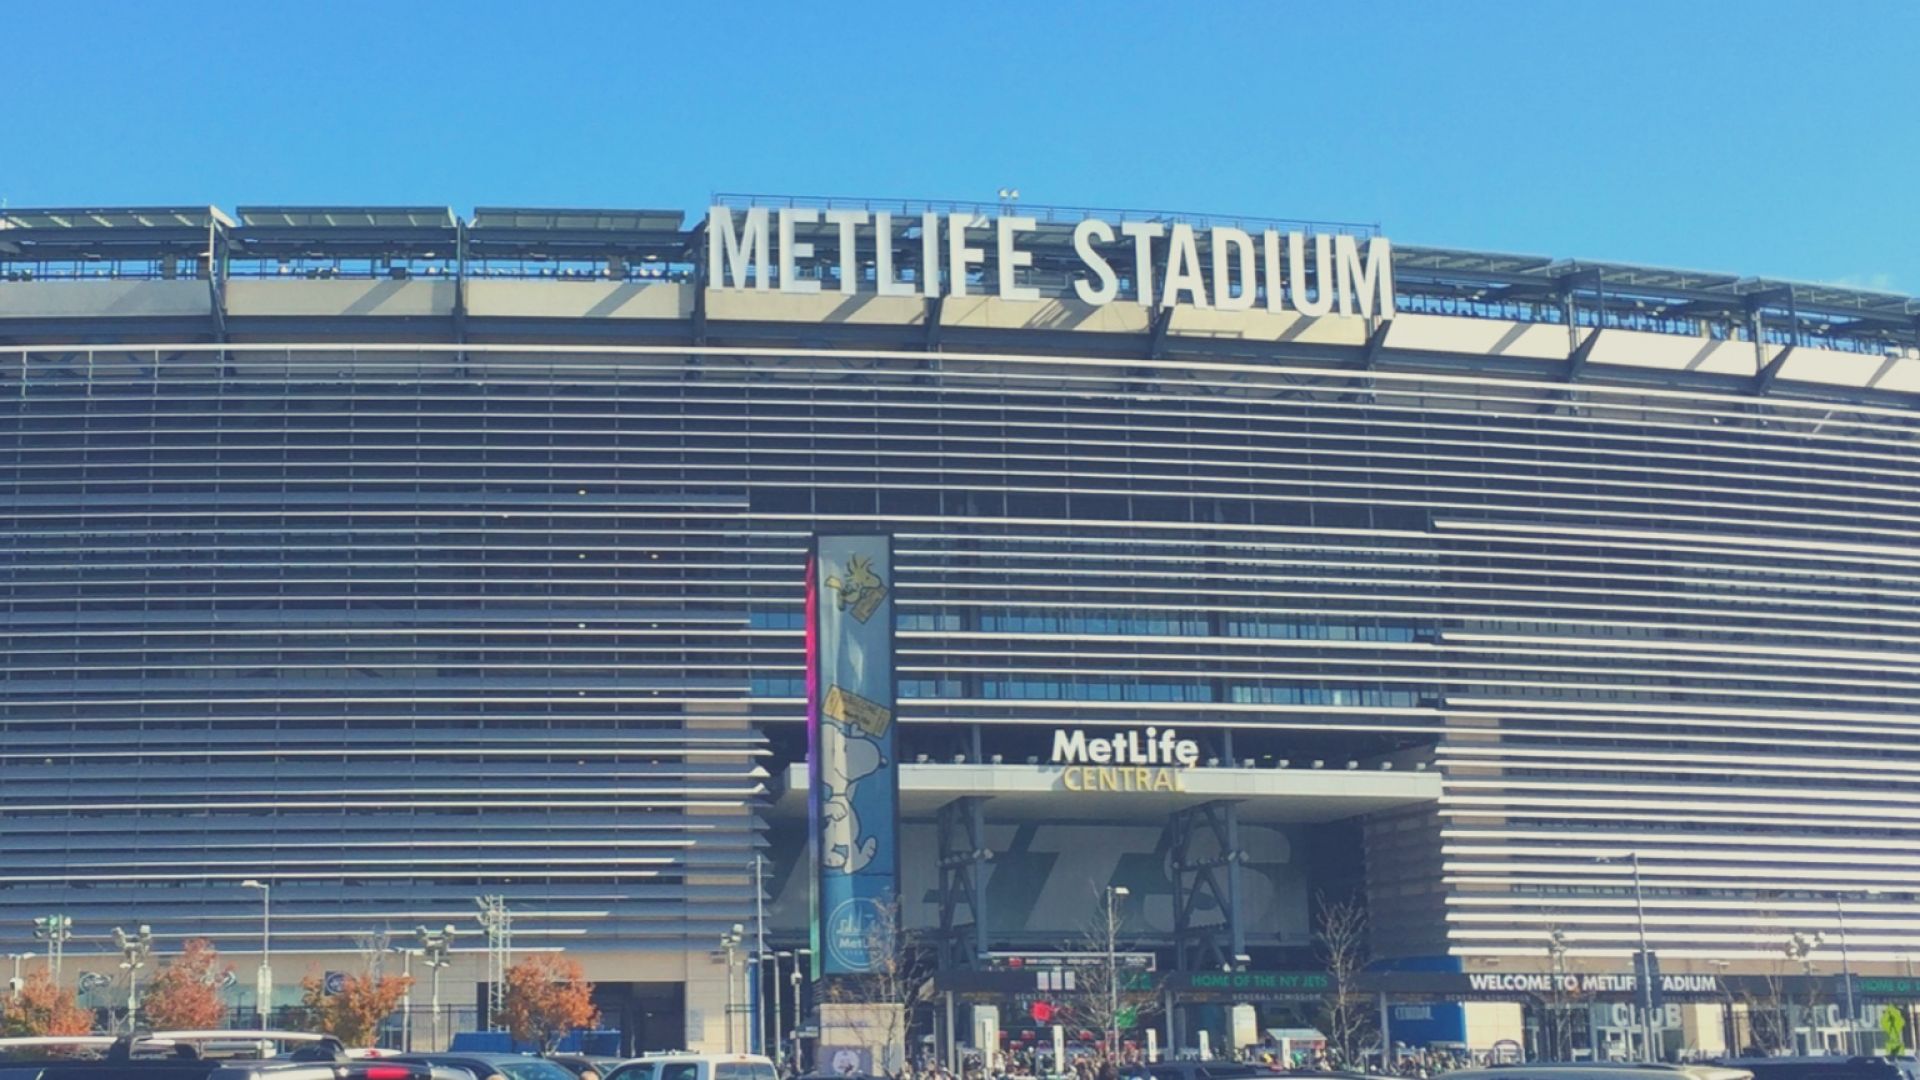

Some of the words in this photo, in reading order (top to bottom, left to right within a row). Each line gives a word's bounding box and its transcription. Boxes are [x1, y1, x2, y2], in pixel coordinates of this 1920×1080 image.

[708, 205, 1041, 302] METLIFE
[1073, 219, 1396, 321] STADIUM
[1051, 727, 1199, 766] MetLife
[1064, 765, 1186, 792] CENTRAL
[1192, 975, 1229, 987] HOME
[1233, 975, 1249, 987] OF
[1253, 975, 1275, 987] THE
[1280, 975, 1299, 987] NY
[1302, 975, 1328, 987] JETS
[1469, 974, 1552, 991] WELCOME
[1554, 974, 1579, 991] TO
[1582, 975, 1637, 992] METLIF
[1660, 976, 1717, 992] ADIUM
[1611, 1002, 1682, 1028] CLUB
